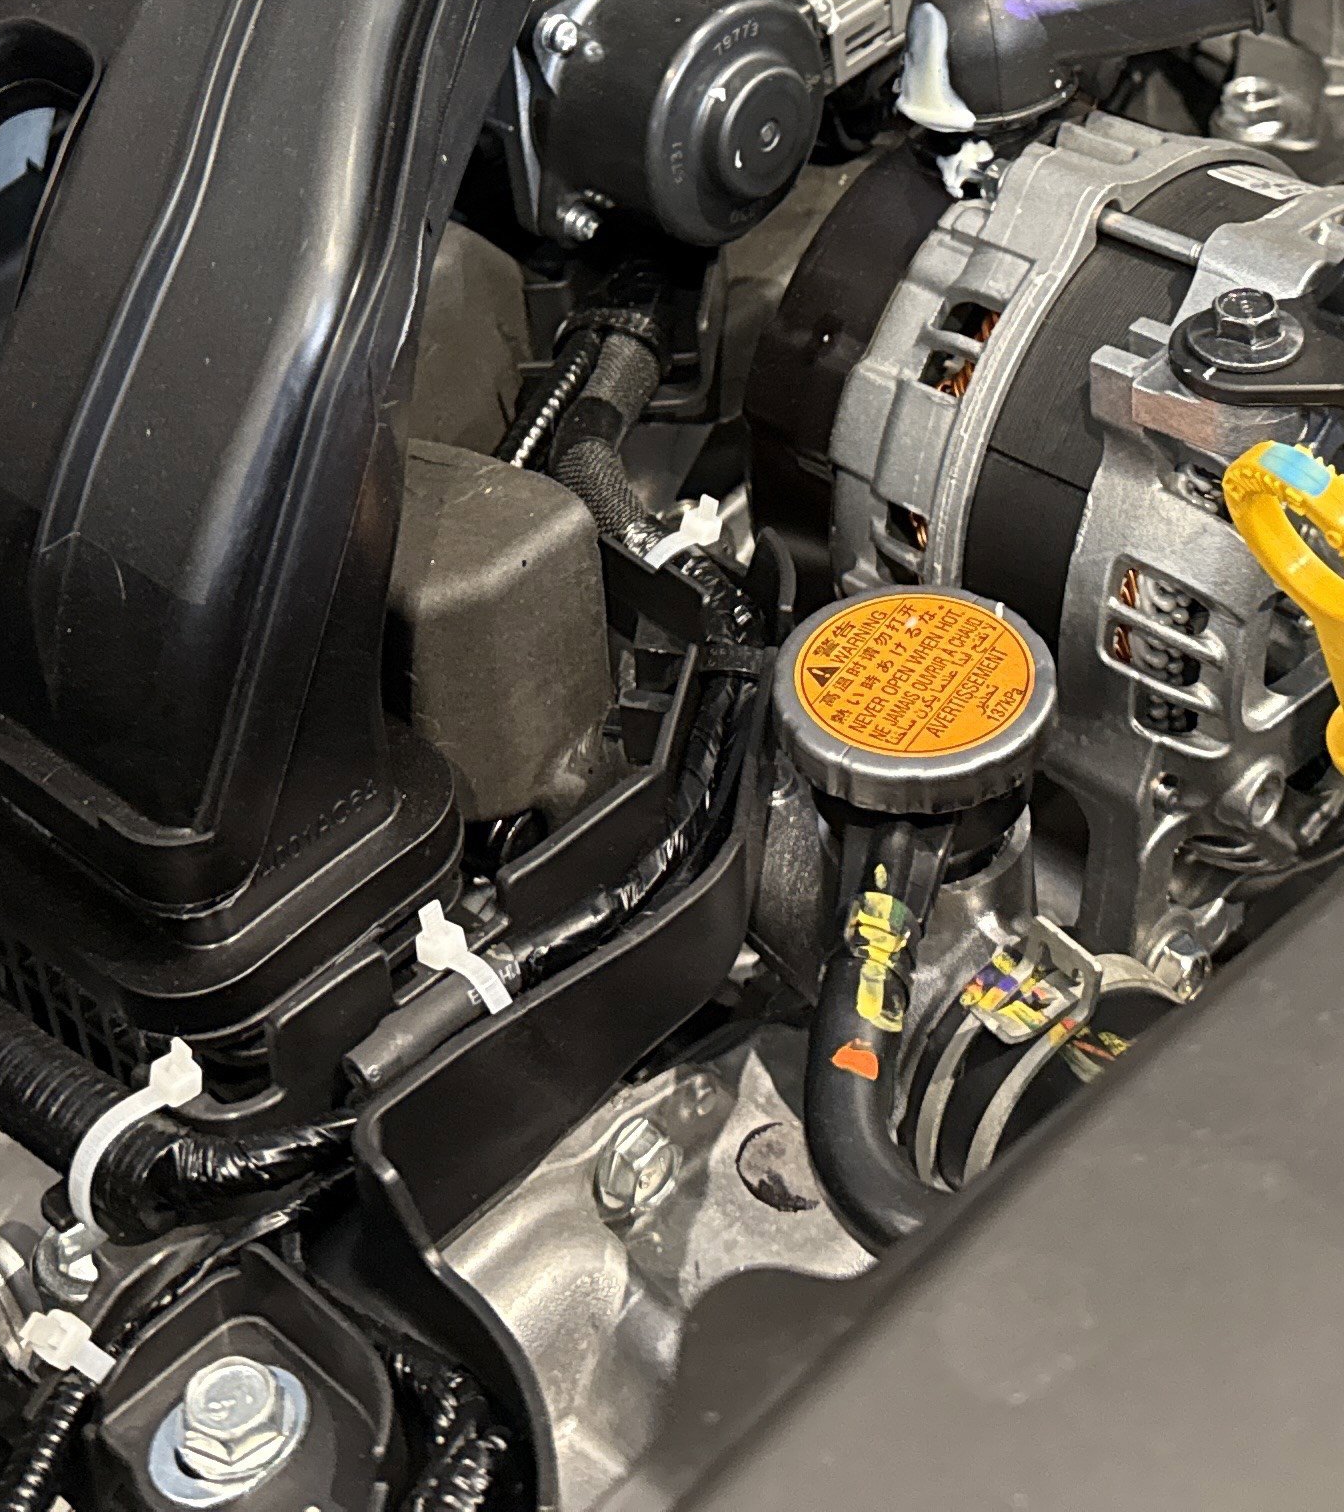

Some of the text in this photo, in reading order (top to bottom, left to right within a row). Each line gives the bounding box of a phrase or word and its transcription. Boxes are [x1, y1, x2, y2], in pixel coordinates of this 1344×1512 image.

[830, 610, 888, 663] WARNING
[848, 608, 966, 733] NEVER OPEN WHEN HOT.
[869, 724, 891, 741] NE
[883, 691, 920, 726] JAMAIS
[911, 656, 948, 692] OUVRIR
[926, 646, 1008, 739] AVERTISSEMENT
[986, 687, 1025, 722] 137kPa
